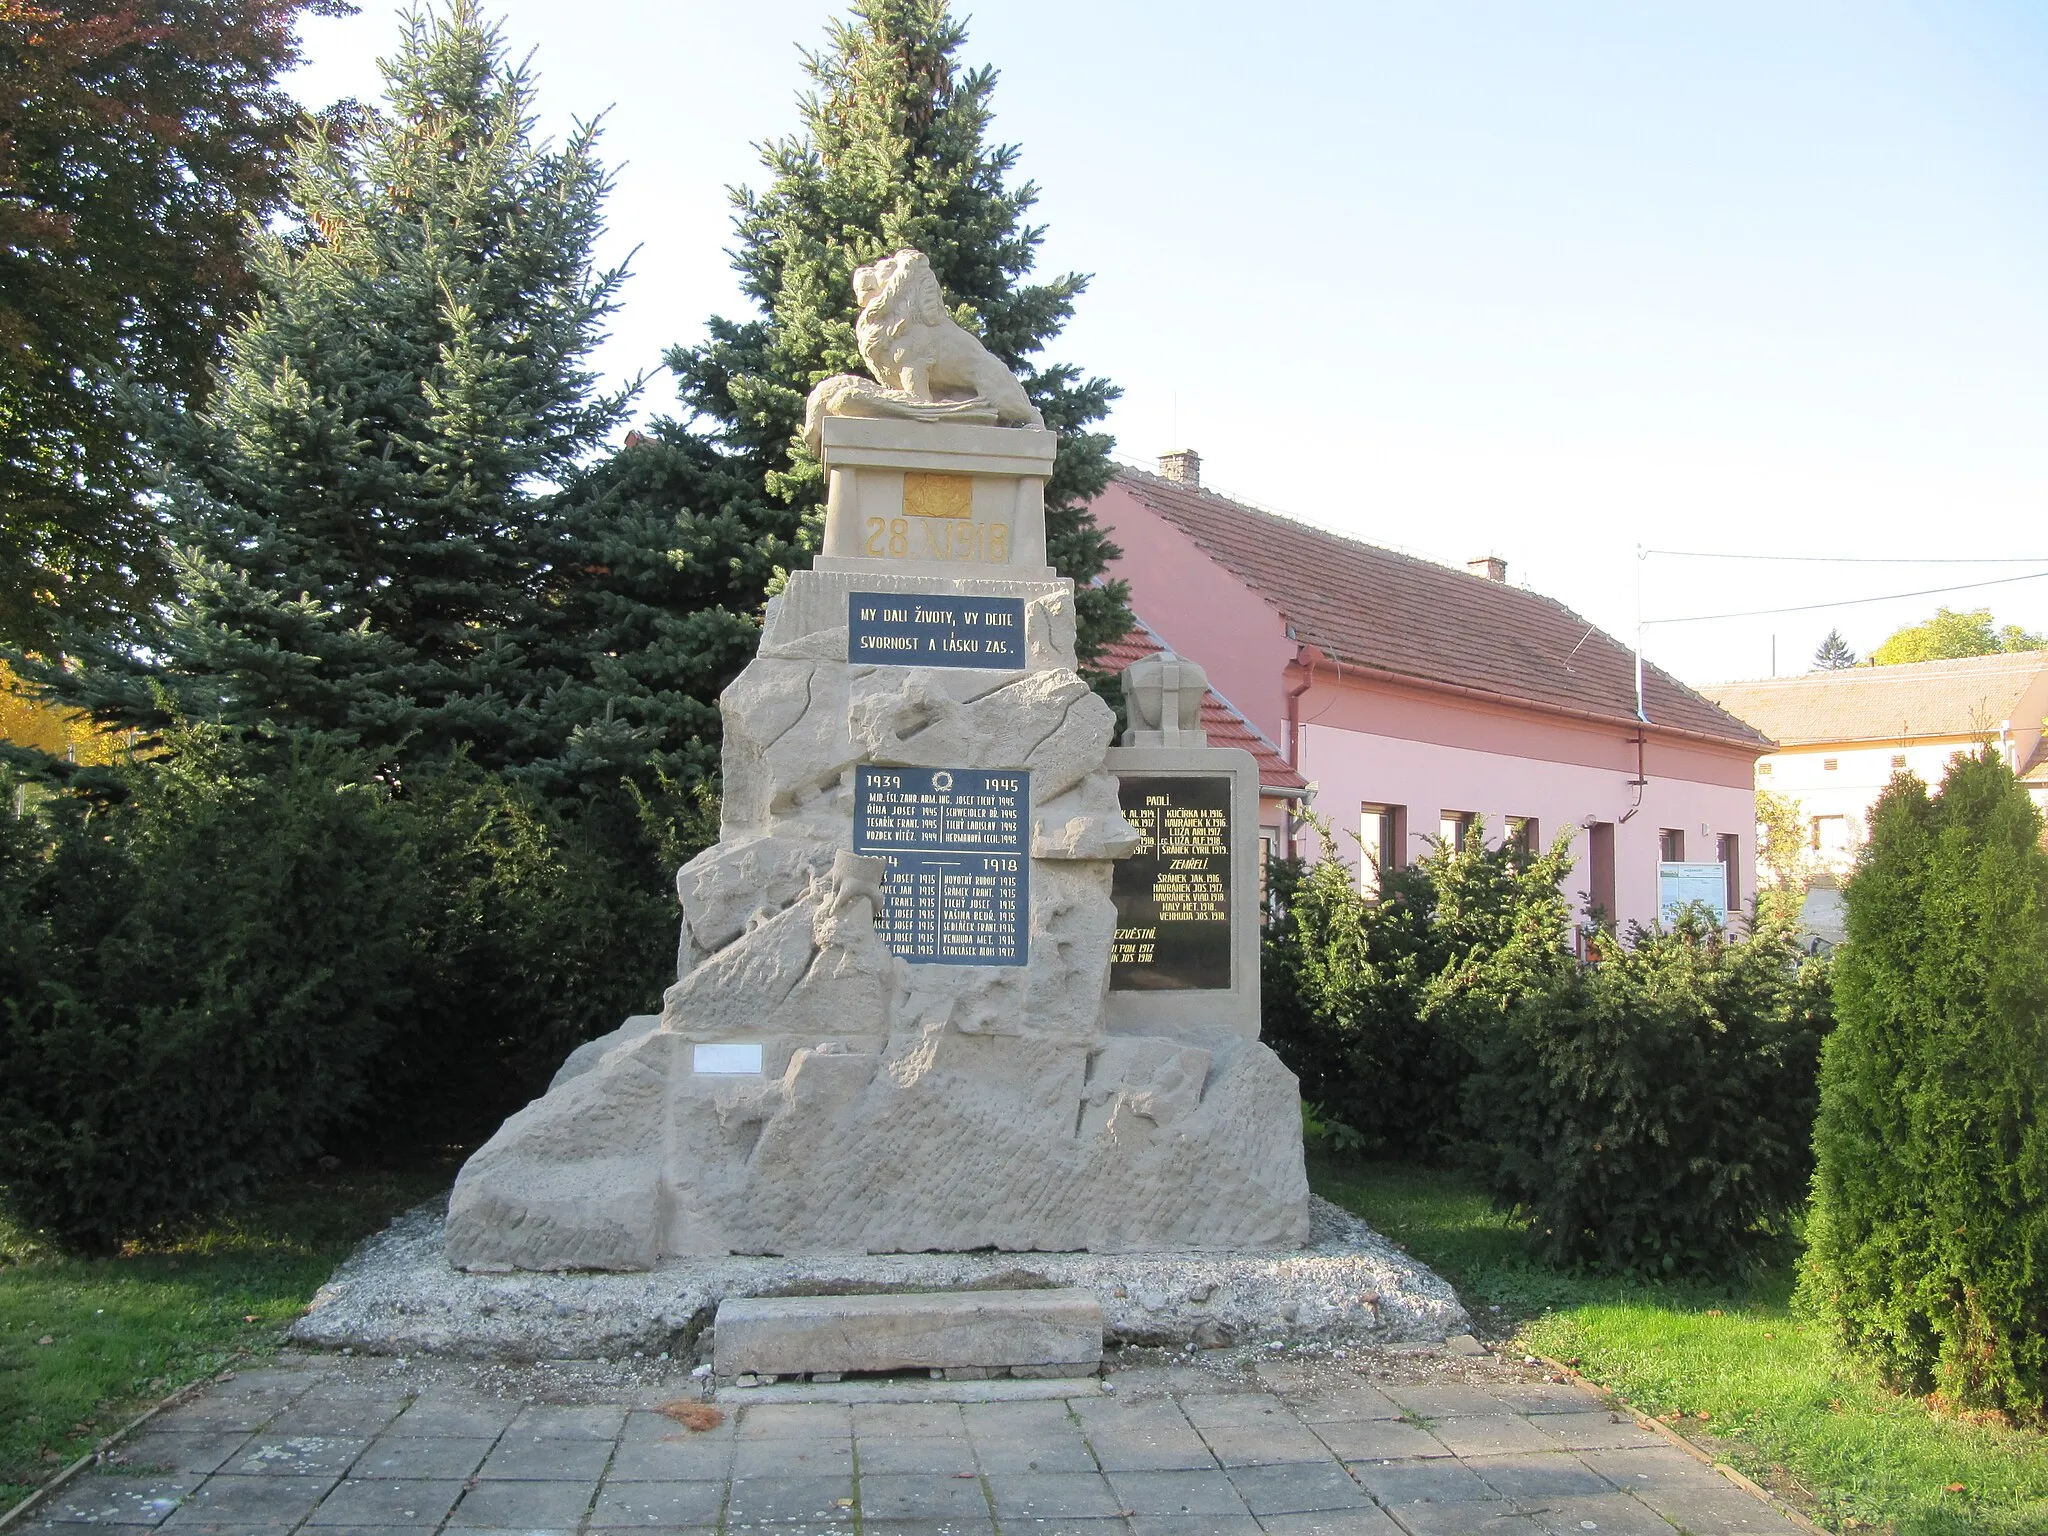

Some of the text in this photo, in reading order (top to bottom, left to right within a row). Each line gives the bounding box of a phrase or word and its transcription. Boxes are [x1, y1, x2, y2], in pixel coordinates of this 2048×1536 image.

[861, 606, 1012, 627] MY DALI ŽIVOTY, VY DEJTE
[860, 632, 1014, 654] SVORNOST A LÁSKU ZAS.
[866, 775, 900, 788] 1939
[984, 779, 1018, 792] 1945
[870, 792, 885, 802] MJR.
[900, 794, 920, 804] ZAHR.
[920, 794, 938, 804] ARM.
[956, 795, 974, 805] JOSEF
[977, 794, 996, 806] TICHÝ
[999, 796, 1014, 806] 1945
[1146, 794, 1172, 806] PADLÍ.
[867, 804, 938, 816] ŘÍHA JOSEF 1945
[946, 808, 986, 818] SCHWEIDLER
[1001, 810, 1017, 818] 1945
[1166, 807, 1198, 818] KUČÍRKA
[897, 819, 920, 828] FRANT.
[922, 820, 938, 829] 1945
[946, 818, 1017, 832] TICHÝ LADISLAV 1943
[1164, 818, 1202, 828] HAVRÁNEK
[866, 830, 892, 840] VOZDEK
[922, 832, 938, 842] 1944
[1170, 826, 1190, 836] LUŽA
[1000, 834, 1017, 844] 1942
[1170, 836, 1190, 845] LUŽA
[984, 858, 1018, 872] 1918
[1169, 858, 1208, 870] ZEMŘELÍ.
[892, 874, 914, 884] JOSEF
[920, 874, 936, 884] 1915
[944, 873, 1016, 886] NOVOTNÝ RUDOLF 1915
[900, 886, 912, 895] JAN
[920, 886, 935, 896] 1915
[1152, 883, 1190, 892] HAVRÁNEK
[972, 888, 994, 898] FRANT.
[1000, 888, 1016, 898] 1915
[1152, 892, 1190, 902] HAVRÁNEK
[890, 897, 915, 907] FRANT.
[919, 898, 935, 907] 1915
[944, 897, 1016, 910] TICHÝ JOSEF 1915
[894, 910, 914, 918] JOSEF
[919, 910, 934, 919] 1915
[1000, 912, 1015, 922] 1915
[894, 921, 913, 930] JOSEF
[918, 922, 934, 930] 1915
[944, 920, 1015, 933] SEDLÁČEK FRANT. 1916
[894, 933, 912, 942] JOSEF
[918, 933, 934, 943] 1915
[1114, 926, 1156, 940] EZVĚSTNÍ.
[943, 934, 1015, 945] VENHUDA MET. 1916
[892, 944, 914, 954] FRANT.
[918, 945, 934, 954] 1915
[980, 946, 995, 956] ALOIS
